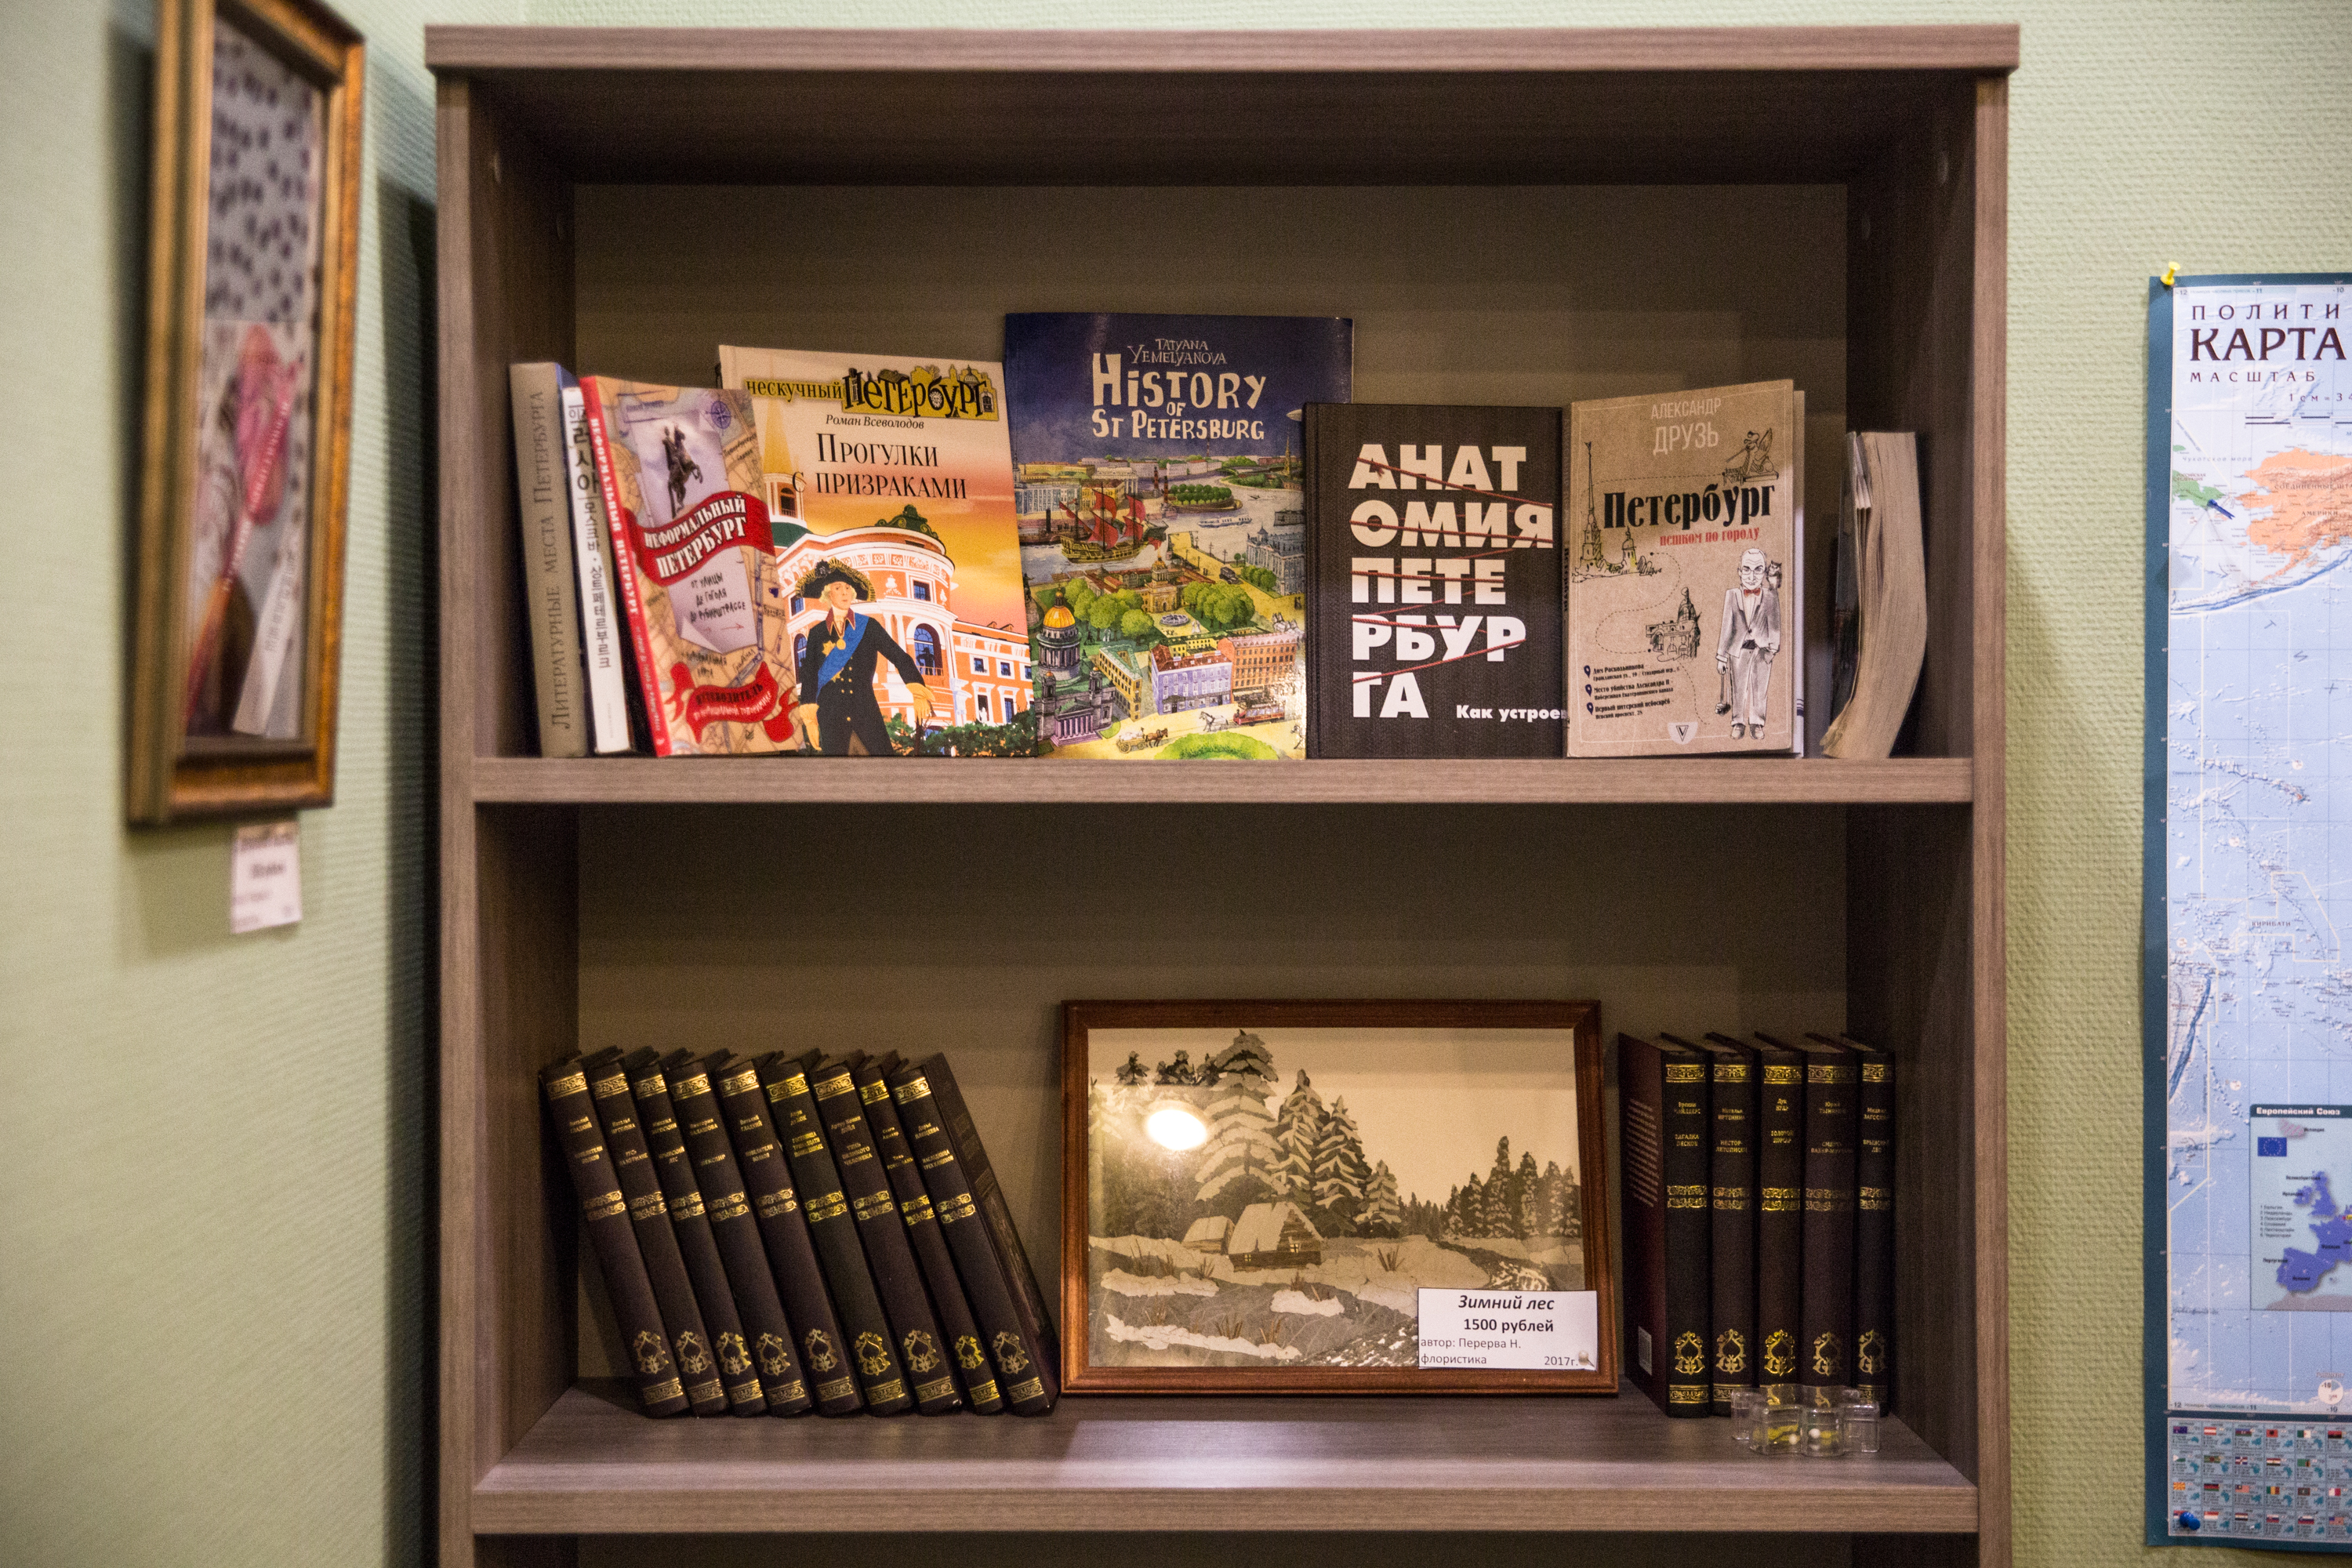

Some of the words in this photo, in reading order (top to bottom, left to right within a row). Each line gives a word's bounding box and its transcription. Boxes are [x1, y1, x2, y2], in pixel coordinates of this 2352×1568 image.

[2191, 303, 2340, 321] ПОЛИТИ
[1127, 344, 1228, 366] YEMELYANOVA
[1156, 338, 1208, 351] TATYANA
[2190, 327, 2347, 361] КАРТА
[1092, 353, 1266, 410] HISTORY
[2190, 371, 2315, 383] МАСШТАБ
[746, 380, 843, 403] нескучный
[1167, 402, 1186, 416] OF
[1651, 397, 1722, 419] АЛЕКСАНДР
[826, 414, 862, 428] Роман
[863, 416, 924, 430] Всеволодов
[1131, 410, 1265, 440] PETERSBURG
[816, 433, 938, 467] ПРОГУЛКИ
[1653, 422, 1719, 456] ДРУЗЬ
[1348, 444, 1526, 492] АНАТ
[815, 473, 967, 500] ПРИЗРАКАМИ
[1603, 483, 1775, 531] Петербург
[644, 495, 747, 550] НЕФОРМАЛЬНЫЙ
[1349, 499, 1553, 549] ОМИЯ
[655, 516, 747, 579] ПЕТЕРБУРГ
[1660, 532, 1702, 546] пешком
[1705, 530, 1719, 543] по
[1722, 527, 1759, 543] городу
[1351, 557, 1506, 604] ПЕТЕ
[1352, 615, 1526, 662] РБУР
[1352, 672, 1429, 718] ГА
[1456, 705, 1494, 719] Как
[2256, 1107, 2313, 1116] Европейский
[2316, 1107, 2340, 1116] Союз
[1458, 1295, 1523, 1310] Зимний
[1526, 1299, 1555, 1310] лес
[1464, 1319, 1497, 1331] 1500
[1502, 1319, 1554, 1334] рублей
[1421, 1339, 1456, 1349] автор:
[1459, 1338, 1507, 1349] Перерва
[1510, 1338, 1522, 1349] Н.
[1421, 1354, 1487, 1367] флористика
[1544, 1356, 1578, 1367] 2017г.
